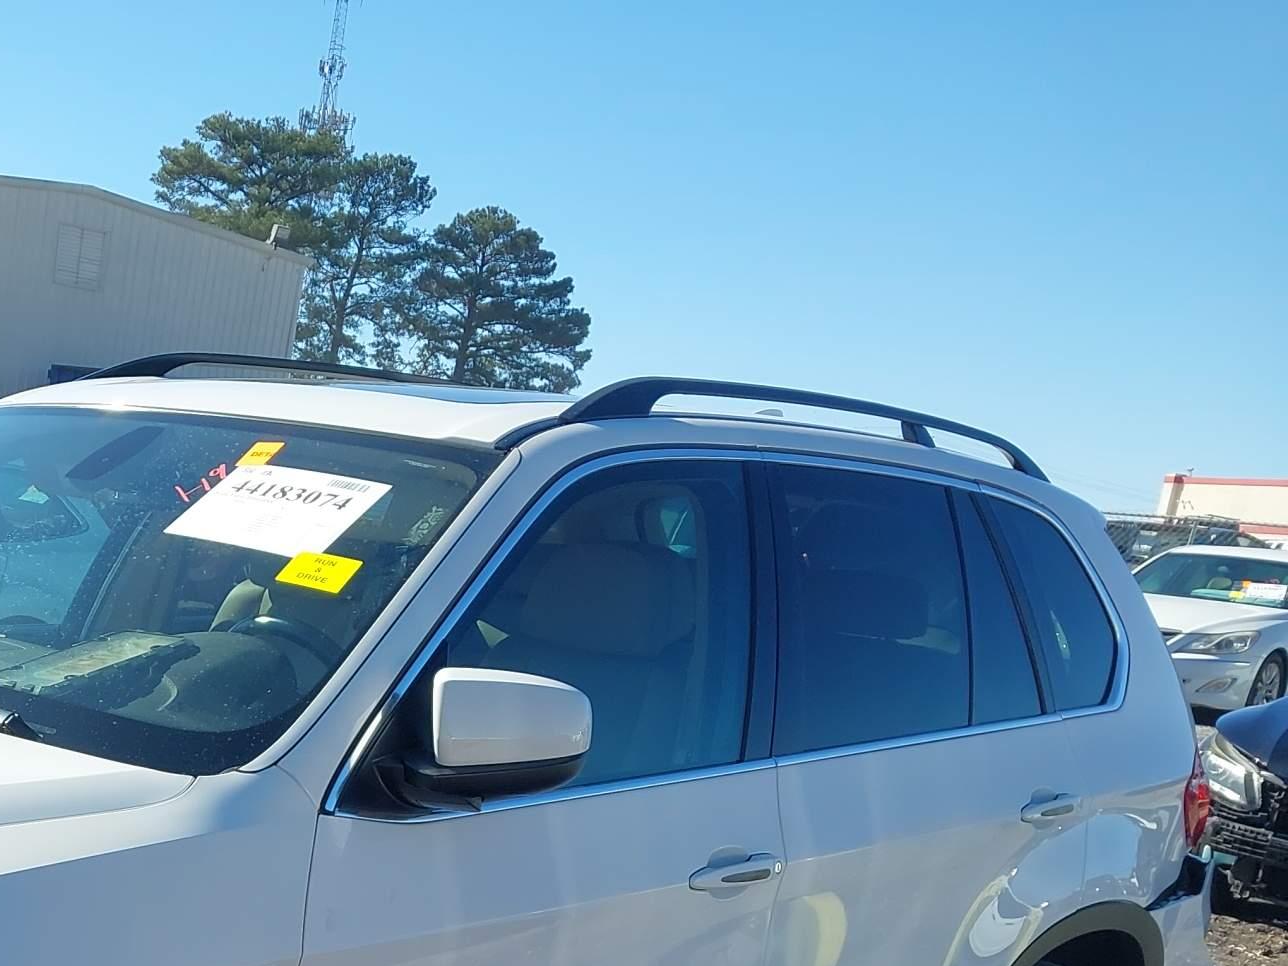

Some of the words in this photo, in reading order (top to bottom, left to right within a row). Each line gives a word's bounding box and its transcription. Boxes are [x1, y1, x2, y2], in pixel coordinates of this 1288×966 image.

[231, 479, 354, 511] 44183074
[314, 557, 338, 568] RUN
[295, 571, 329, 584] DRIVE
